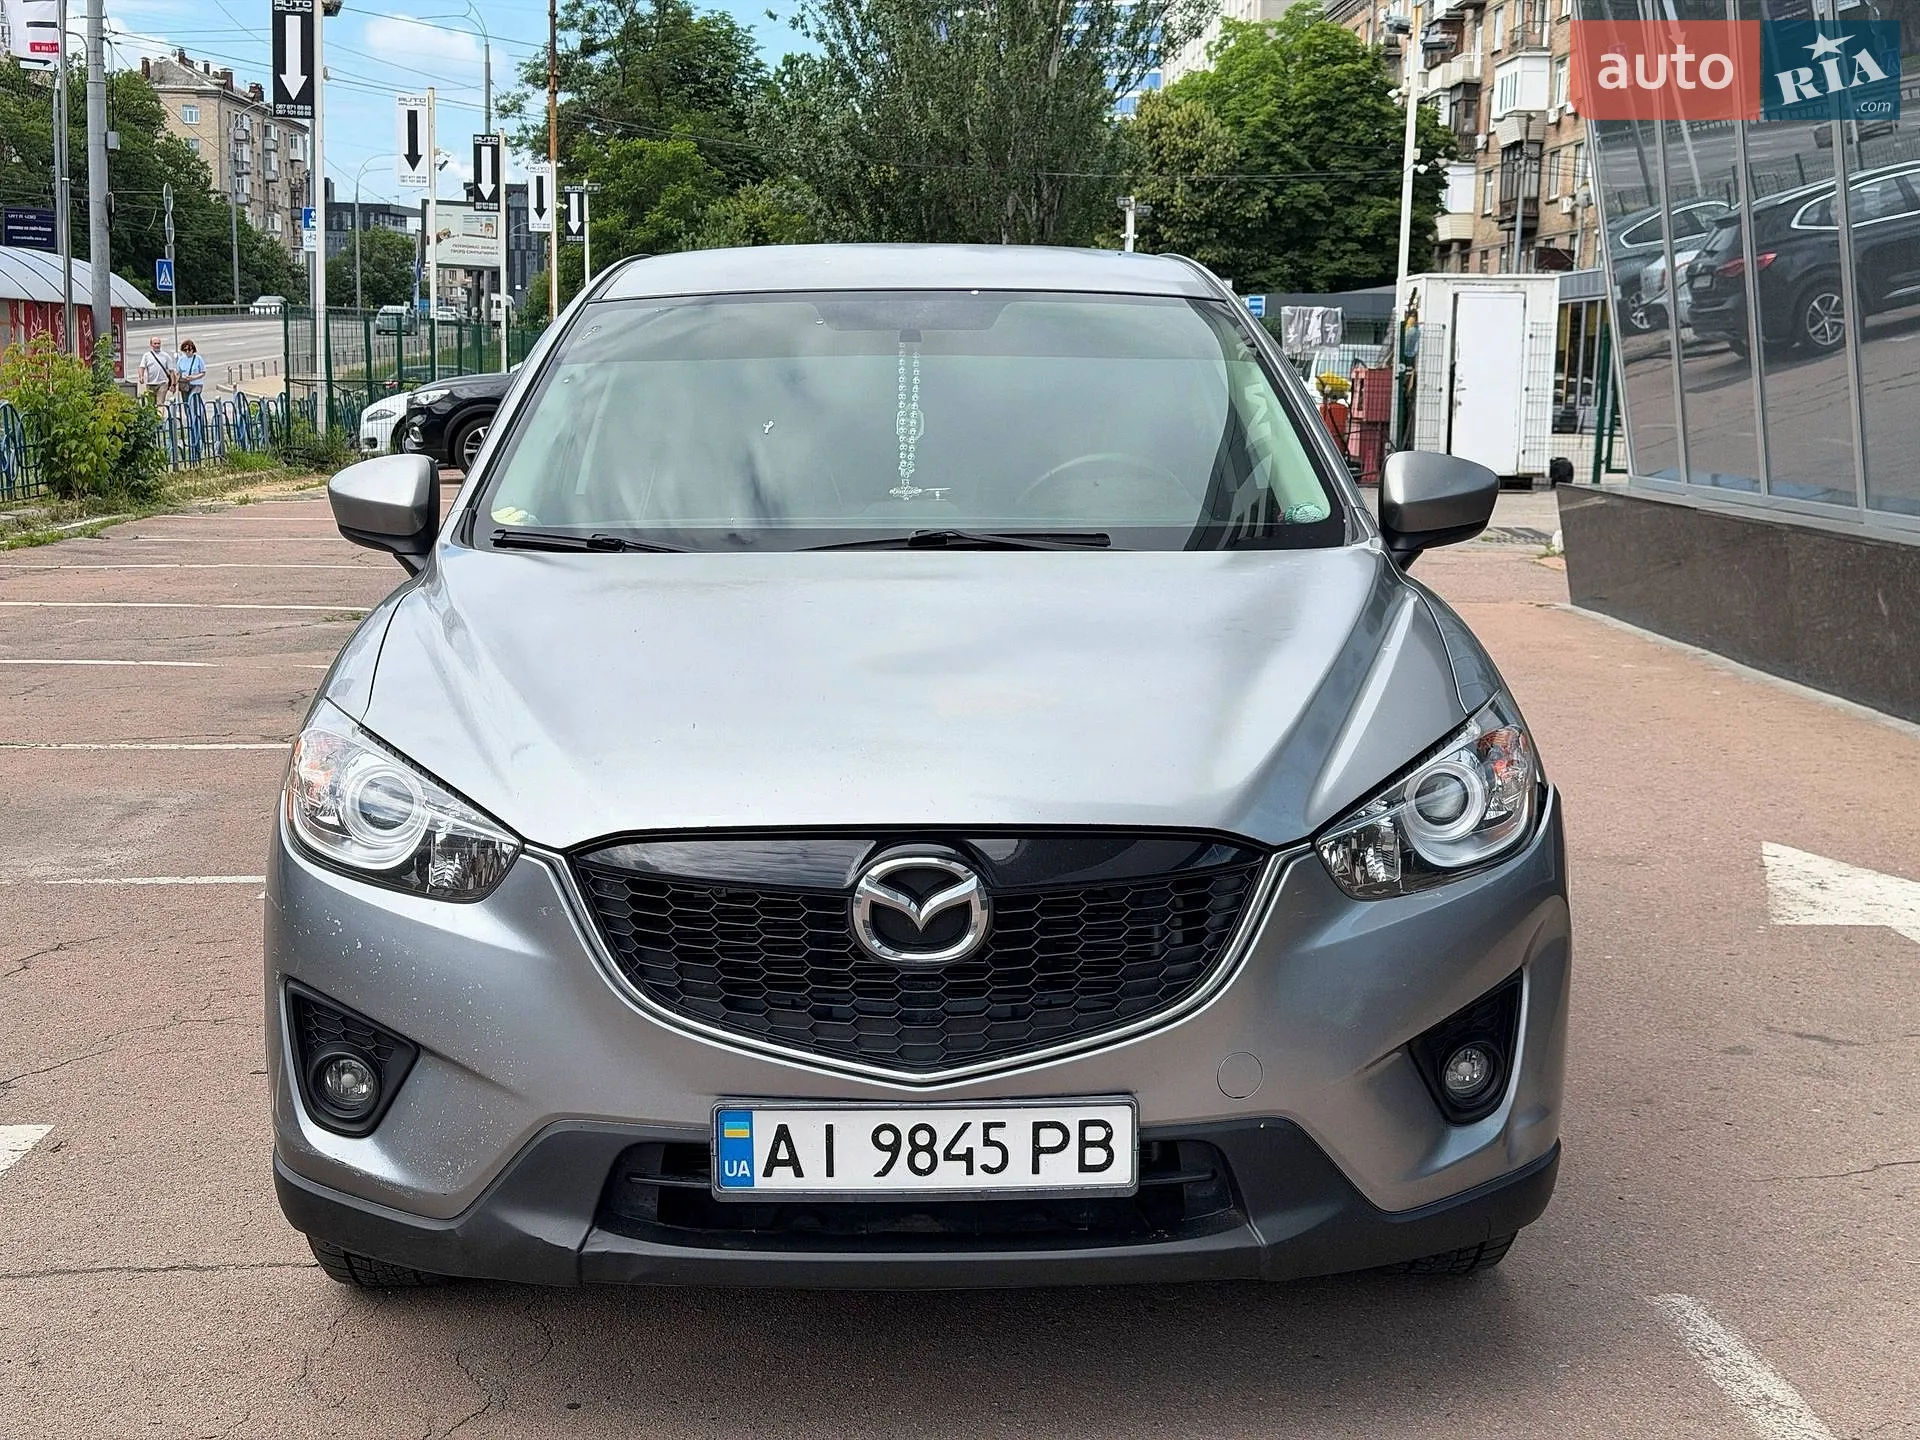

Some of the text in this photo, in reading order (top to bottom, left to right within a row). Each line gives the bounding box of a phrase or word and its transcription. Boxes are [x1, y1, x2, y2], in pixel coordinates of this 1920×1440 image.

[274, 0, 312, 8] AUTO
[762, 1118, 1116, 1179] AI 9845 PB
[724, 1160, 752, 1178] UA
